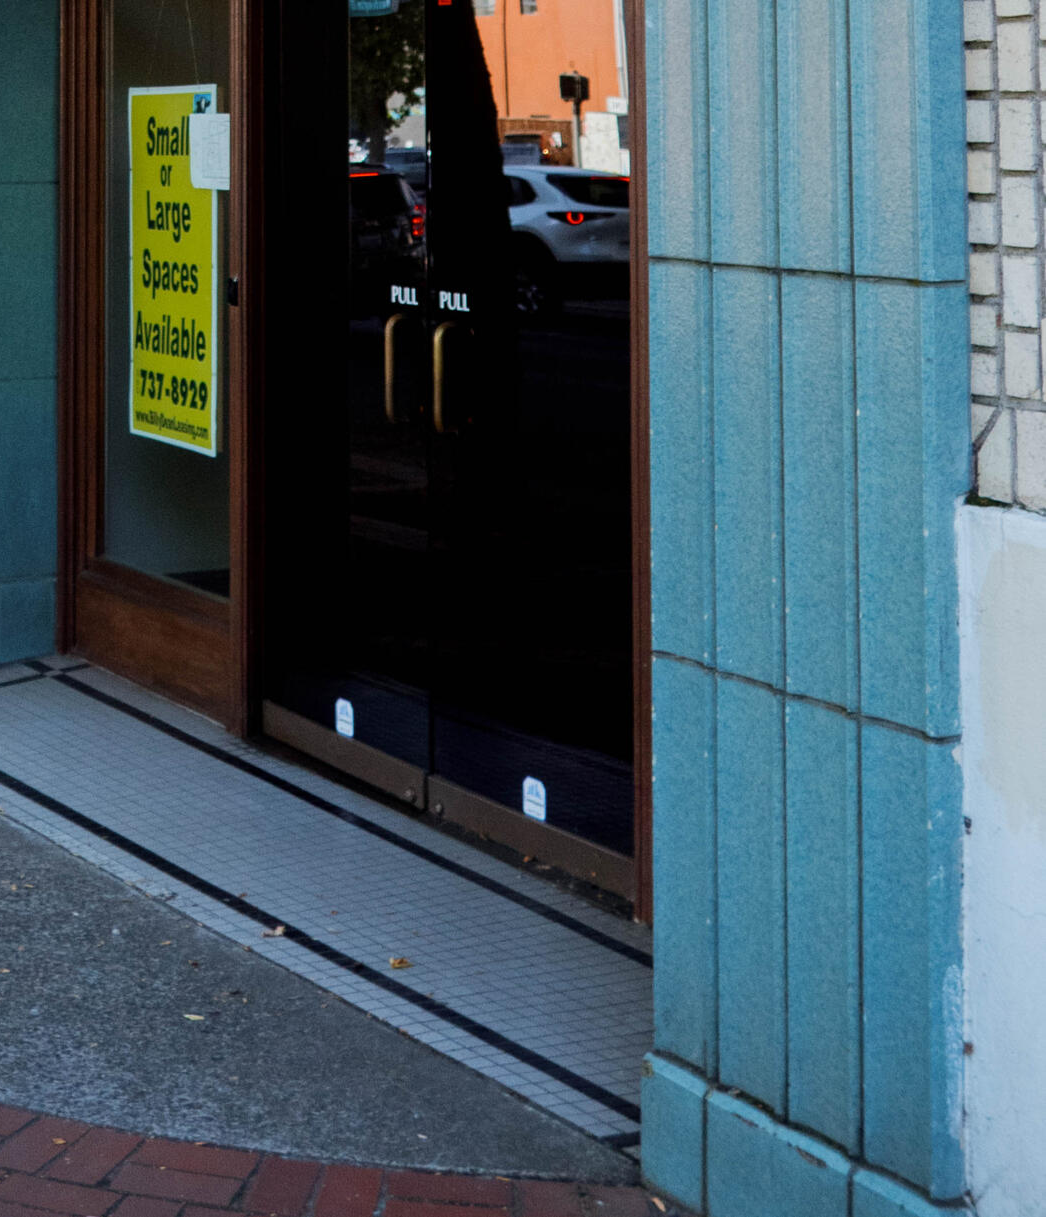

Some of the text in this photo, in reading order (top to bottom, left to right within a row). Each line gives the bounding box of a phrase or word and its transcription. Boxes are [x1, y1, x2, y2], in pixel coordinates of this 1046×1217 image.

[146, 116, 190, 157] Small
[160, 164, 173, 187] or
[146, 190, 191, 243] Large
[142, 248, 199, 300] Spaces
[391, 285, 419, 306] PULL
[439, 290, 470, 312] PULL
[134, 309, 207, 362] Available
[140, 369, 209, 412] 737-8929
